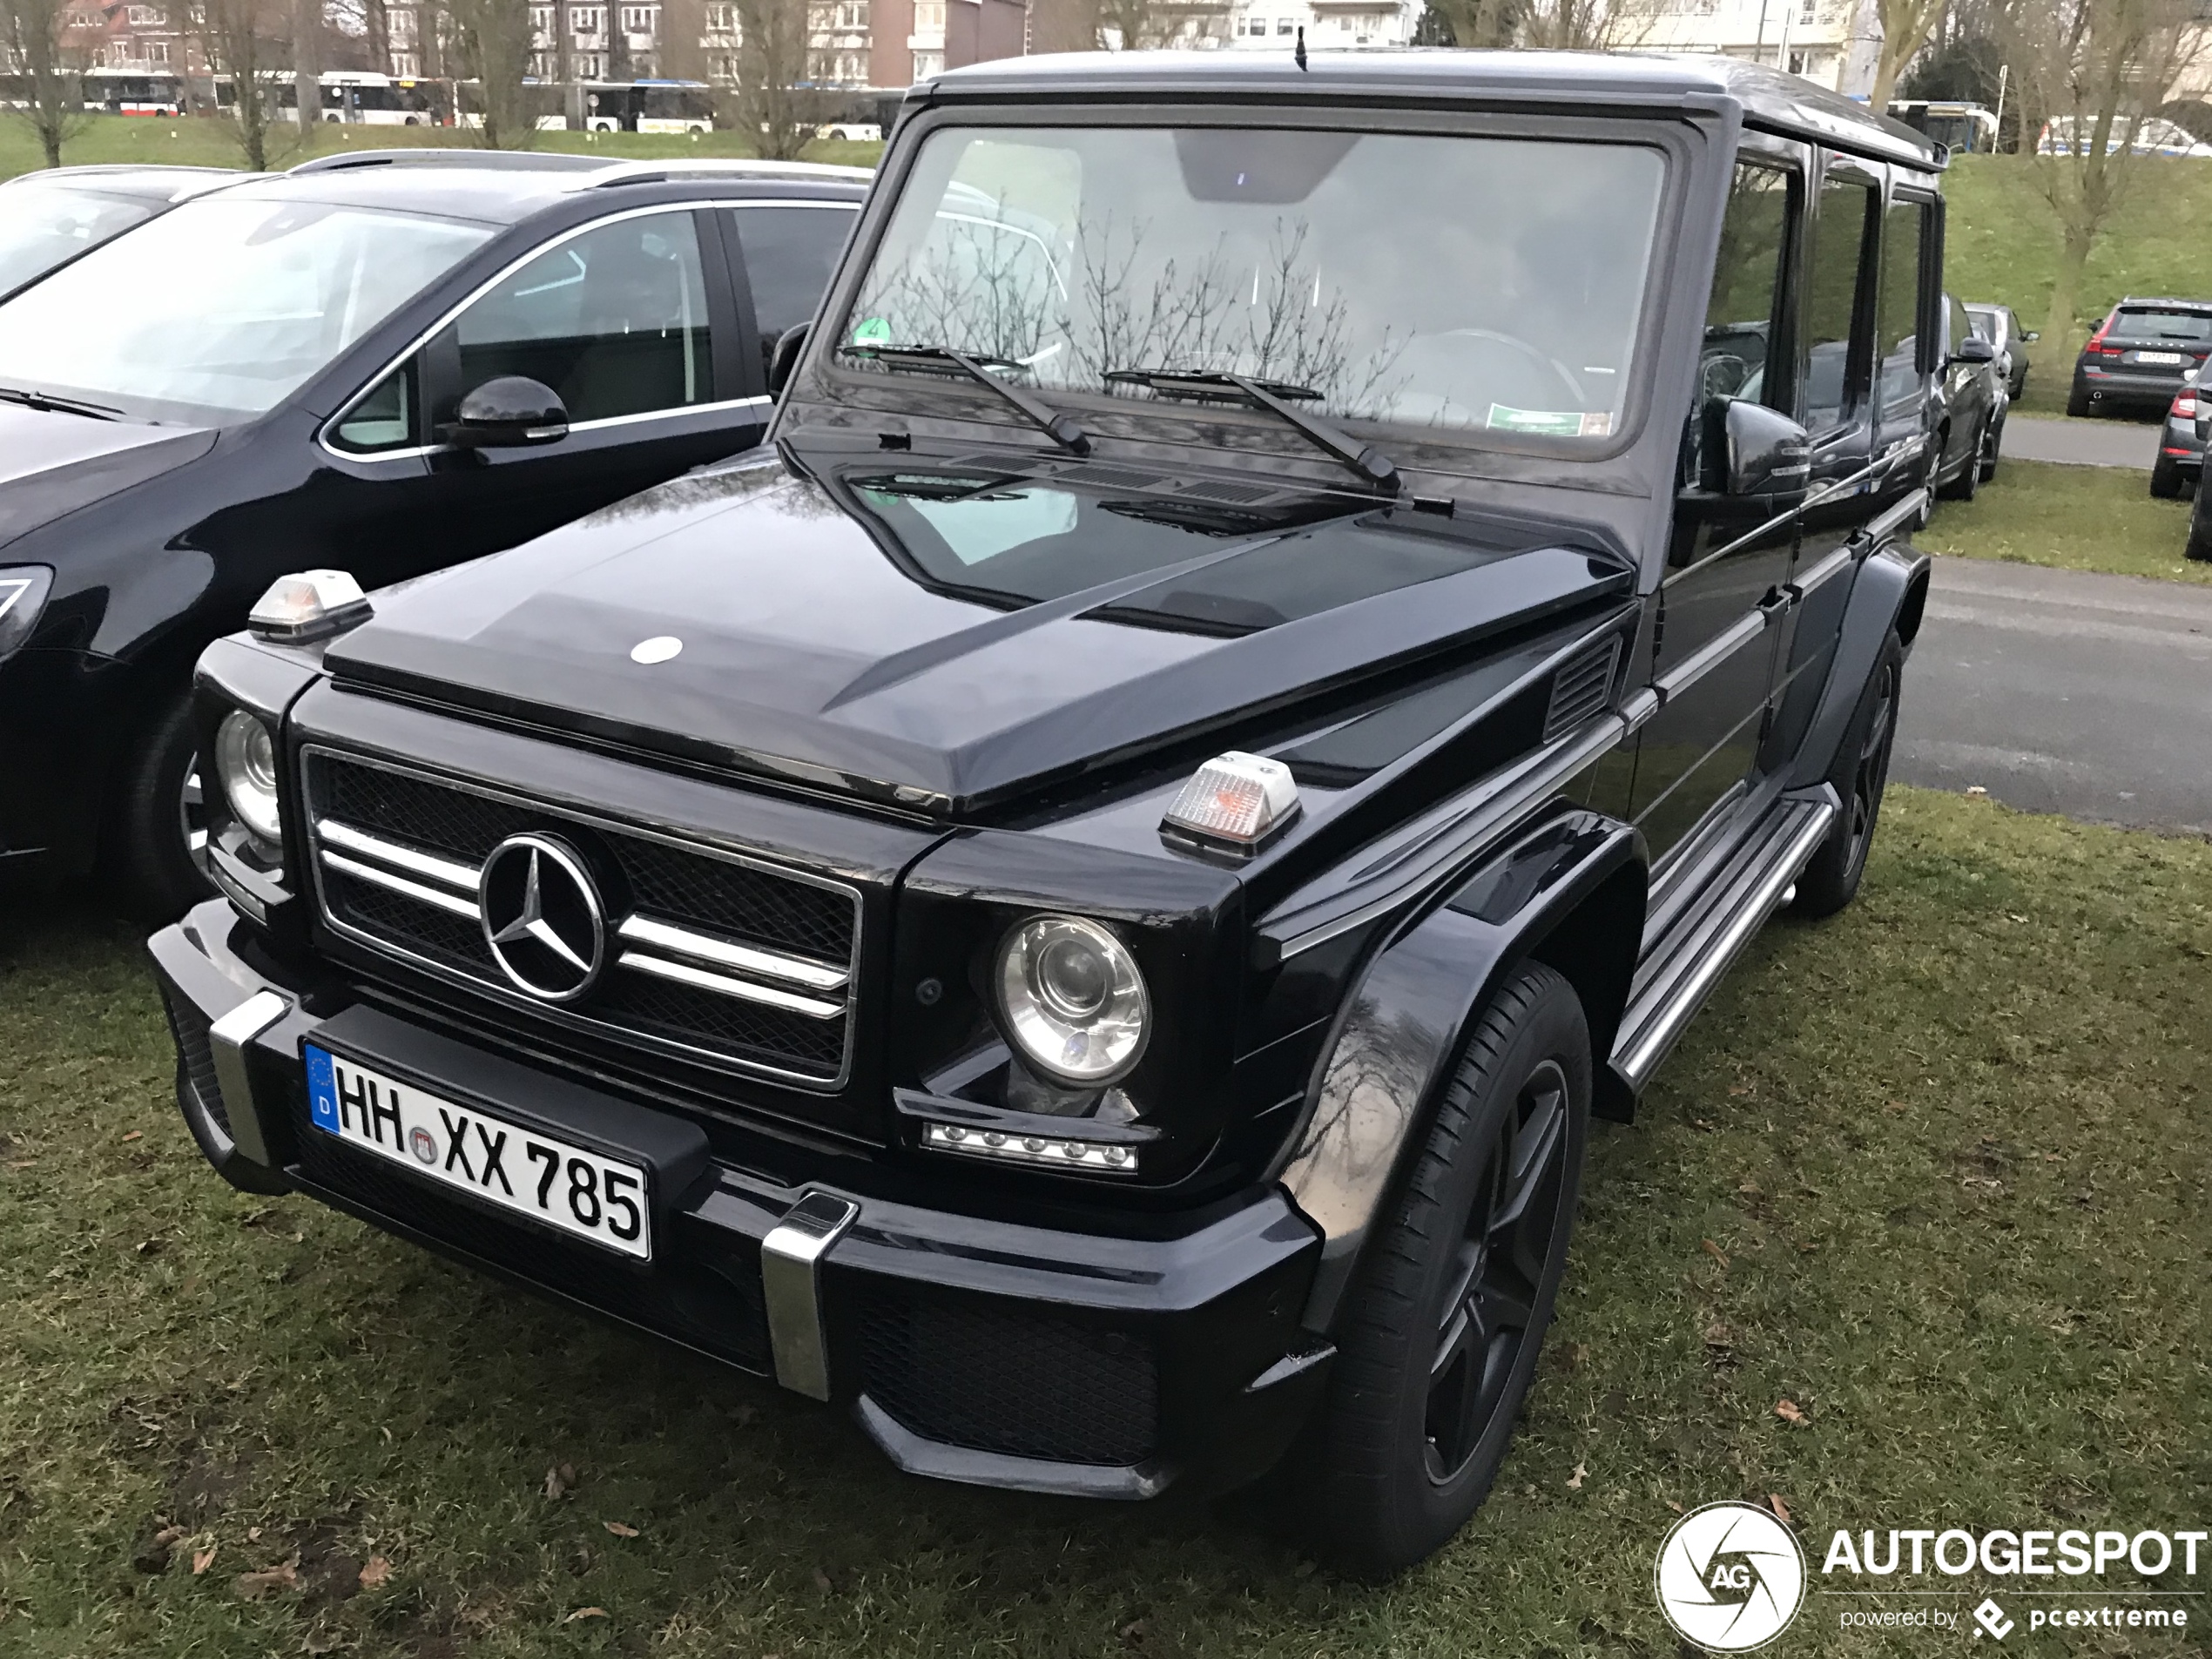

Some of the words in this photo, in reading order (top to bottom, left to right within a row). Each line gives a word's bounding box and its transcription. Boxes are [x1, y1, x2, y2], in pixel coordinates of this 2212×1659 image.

[319, 1096, 330, 1115] D
[335, 1066, 405, 1152] HH
[438, 1108, 514, 1197] XX
[526, 1141, 641, 1242] 785
